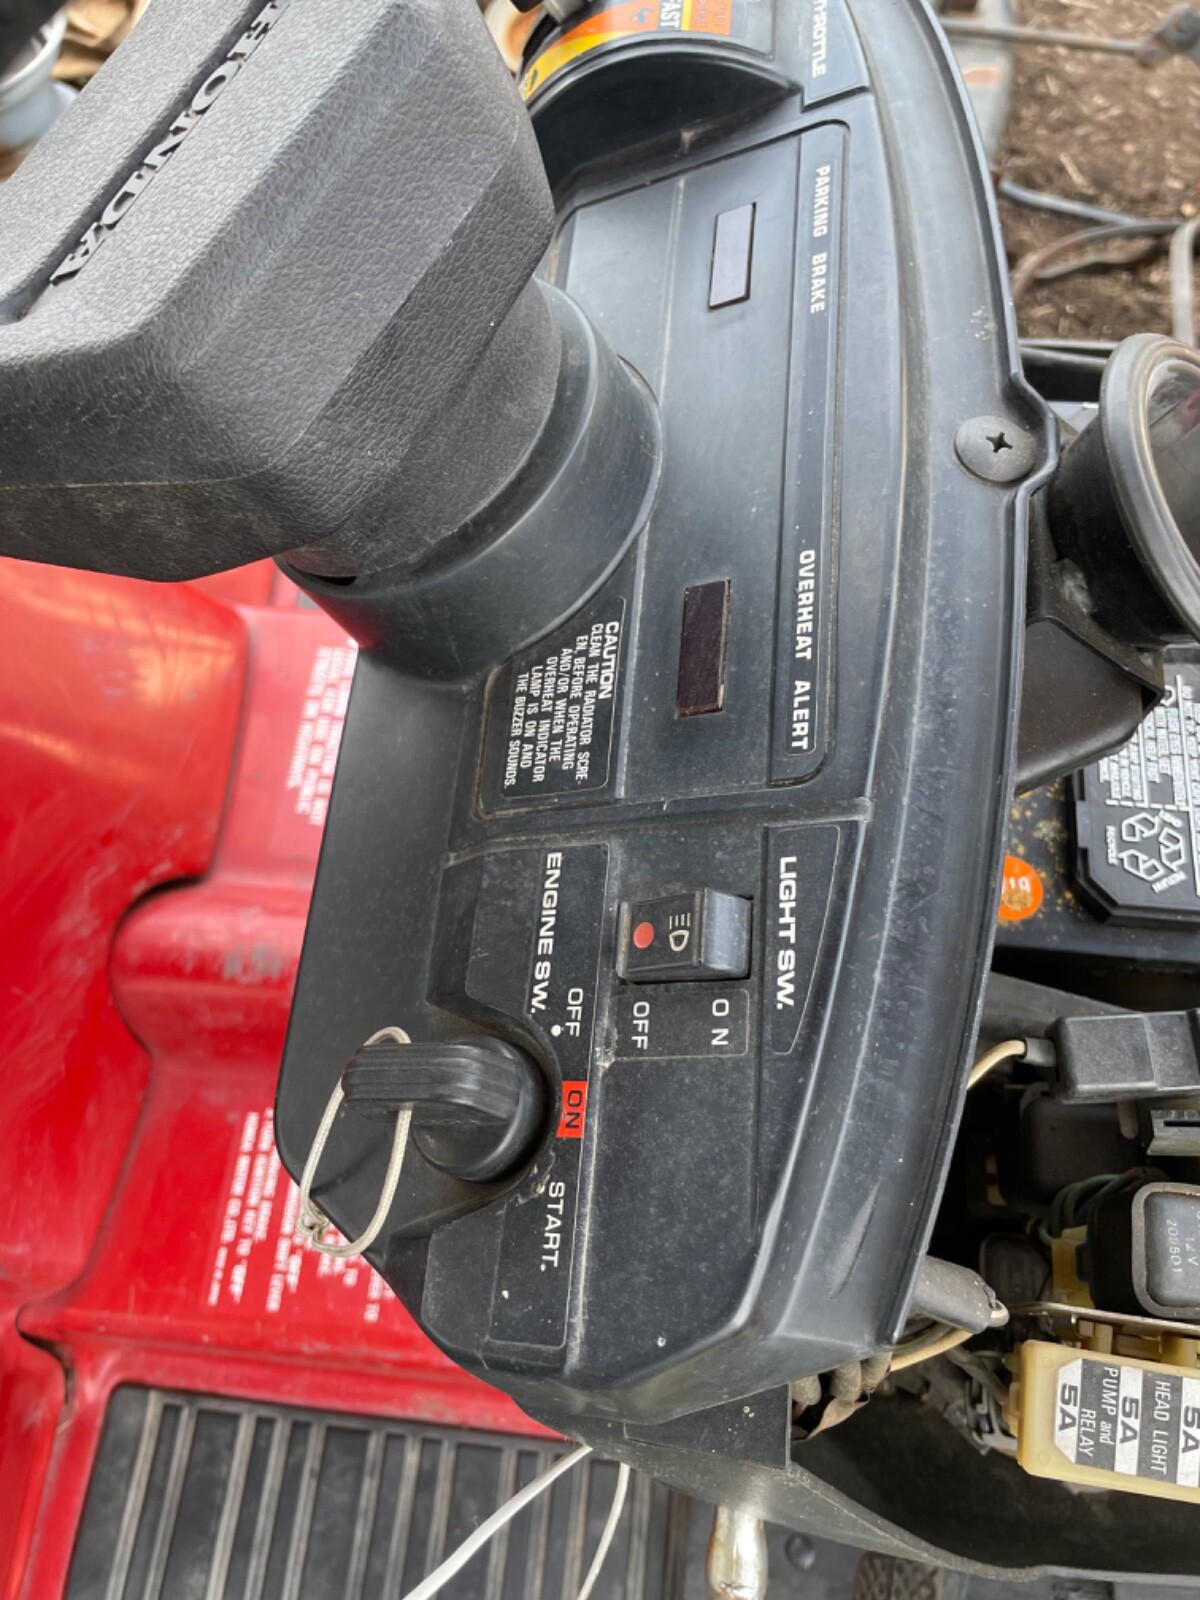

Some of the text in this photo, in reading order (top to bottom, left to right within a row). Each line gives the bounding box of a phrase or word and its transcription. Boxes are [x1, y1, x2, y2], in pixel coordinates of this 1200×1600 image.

[49, 0, 286, 287] HONDA
[810, 164, 830, 314] PARKING BRAKE
[570, 657, 585, 699] BEFORE
[598, 621, 619, 699] CAUTION
[791, 550, 815, 750] OVERHEAT ALERT
[504, 672, 529, 789] THE BUZZER SOUNDS.
[520, 666, 543, 768] LAMP IS ON AND
[532, 657, 557, 782] OVERHEAT INDICATOR
[549, 648, 572, 762] AND/OR WHEN THE
[562, 705, 580, 770] OPERATING
[575, 624, 603, 784] CLEAN THE RADIATOR SCRE-
[530, 852, 563, 1014] ENGINE SW.
[776, 856, 797, 1010] LIGHT SW.
[565, 988, 584, 1037] OFF
[632, 1001, 650, 1050] OFF
[565, 1090, 583, 1129] ON
[1058, 1384, 1078, 1431] 5A
[1079, 1408, 1096, 1457] RELAY
[1100, 1367, 1118, 1445] PUMP and
[1120, 1396, 1139, 1444] 5A
[1151, 1380, 1170, 1474] HEAD LIGHT
[1182, 1406, 1200, 1454] 5A
